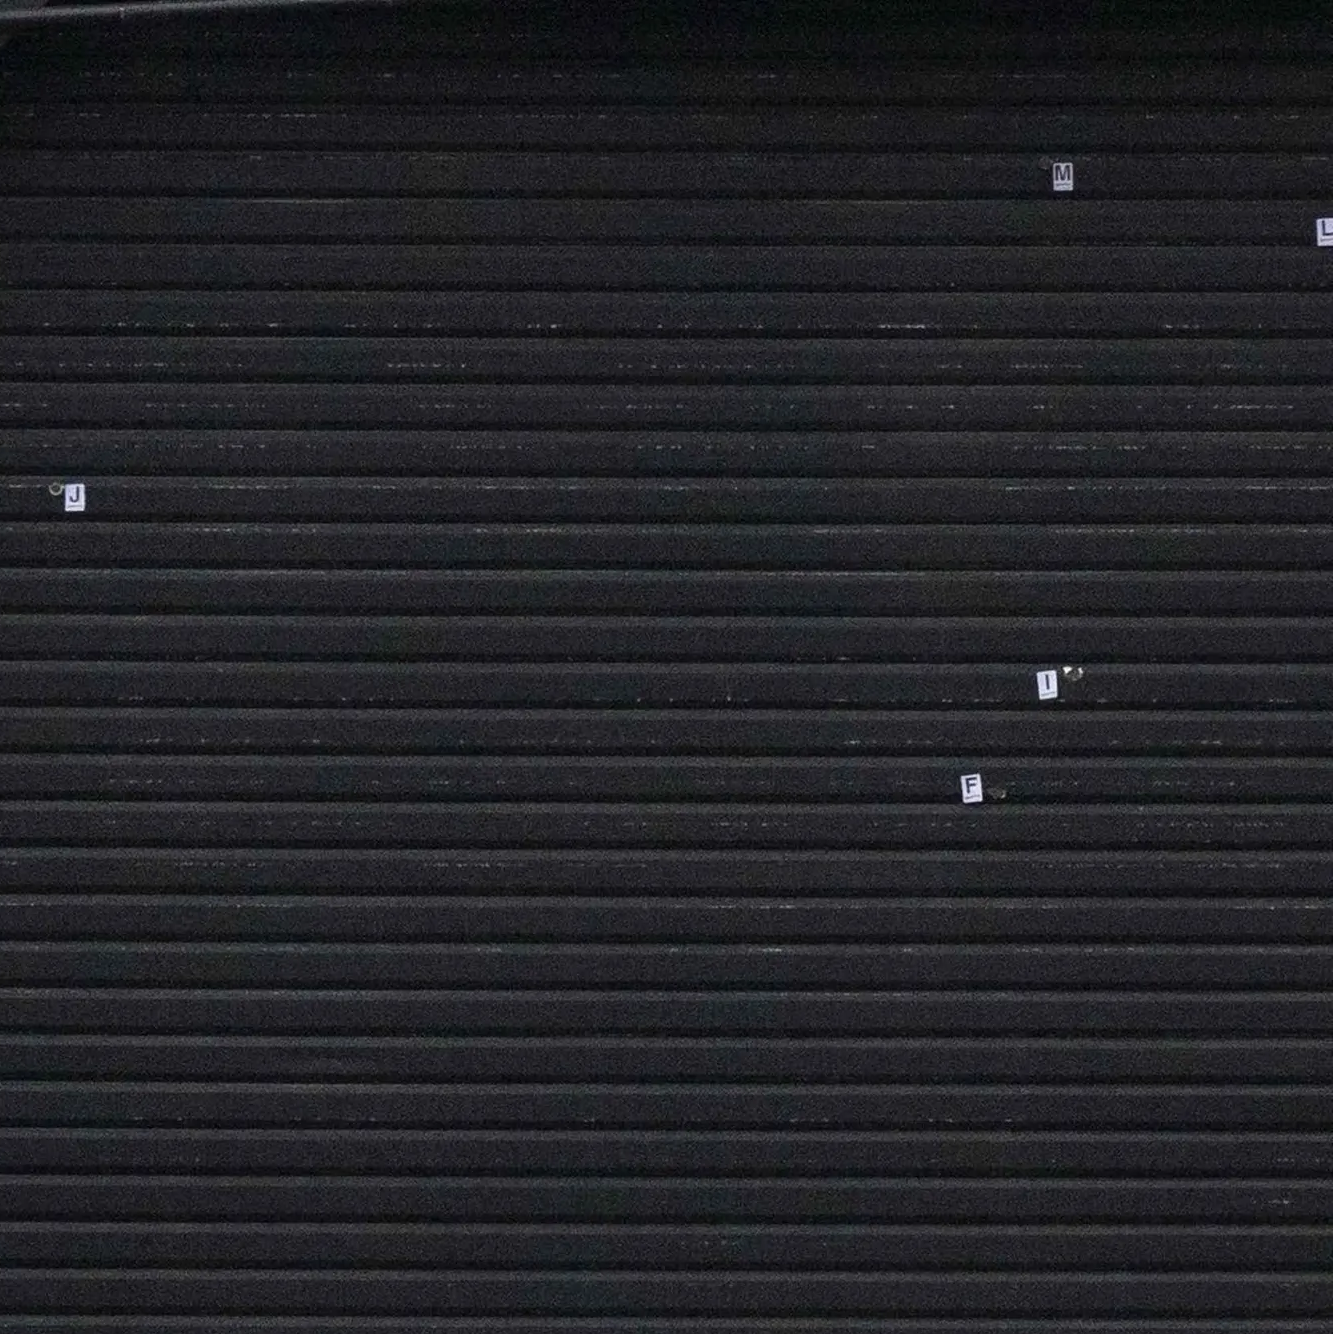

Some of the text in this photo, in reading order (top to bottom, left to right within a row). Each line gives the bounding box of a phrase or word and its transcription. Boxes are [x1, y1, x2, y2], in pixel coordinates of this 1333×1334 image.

[1055, 165, 1071, 181] M
[1320, 220, 1333, 236] L
[69, 485, 81, 503] J
[965, 776, 978, 793] F
